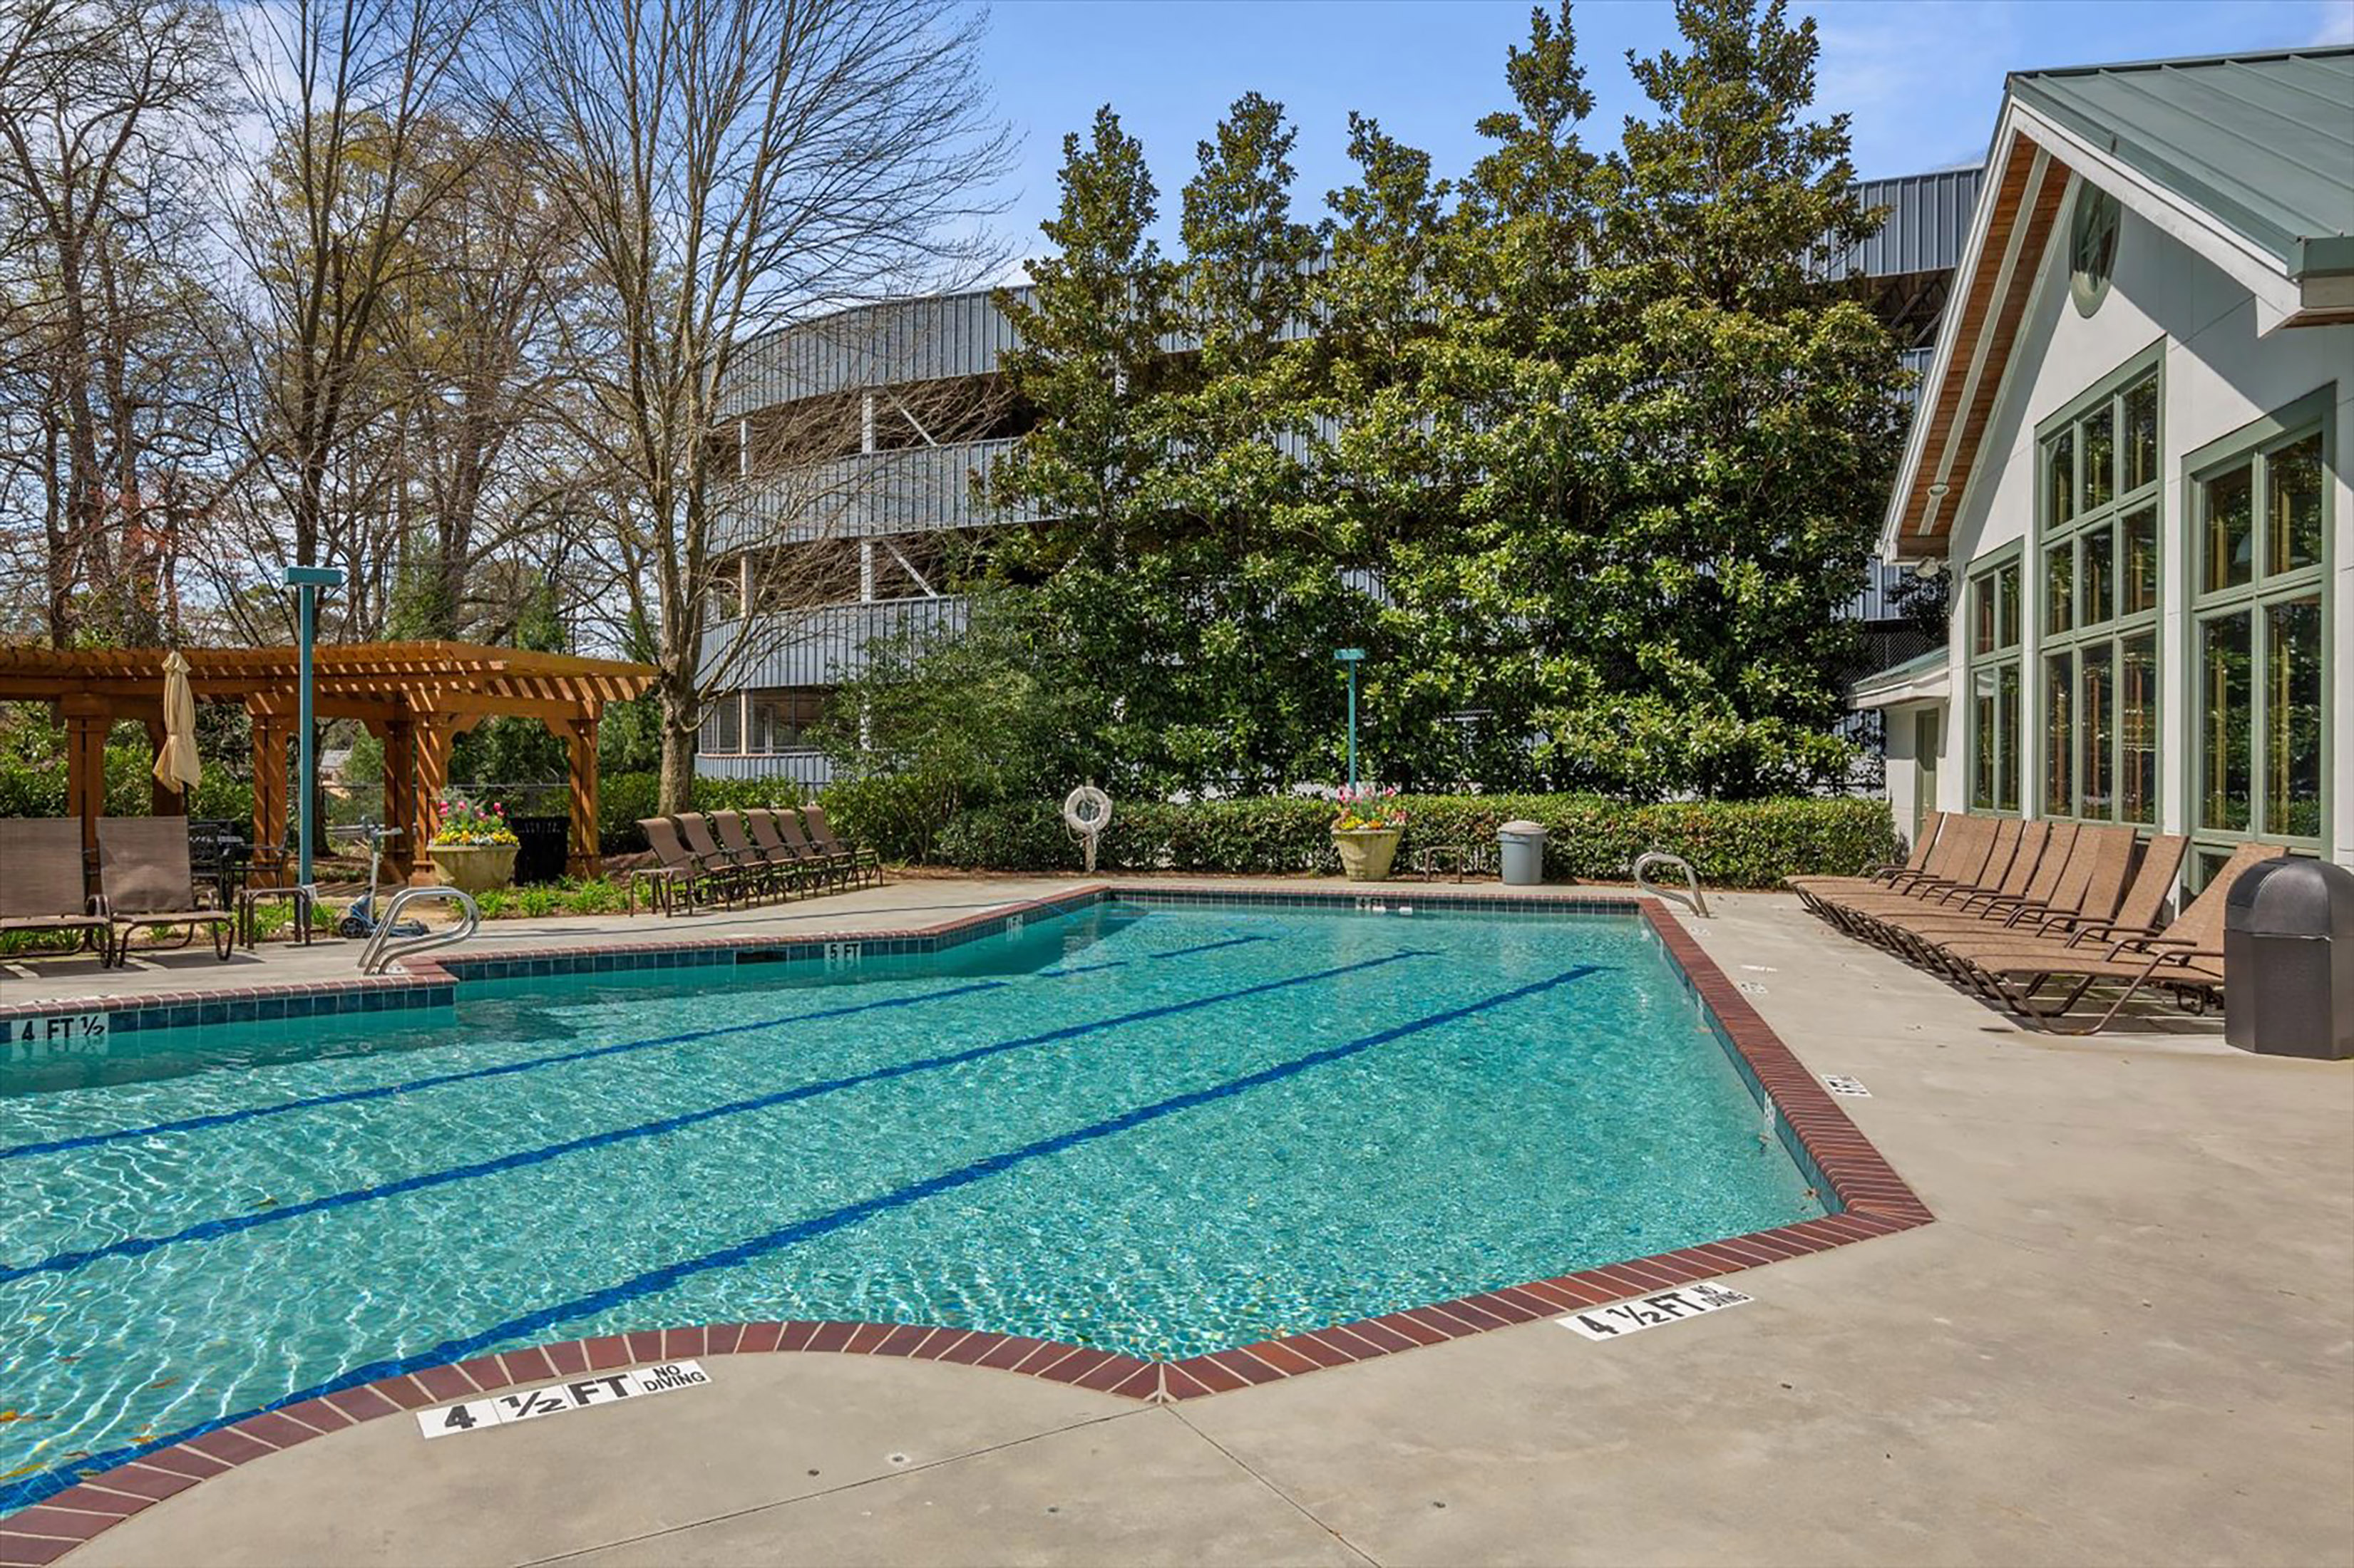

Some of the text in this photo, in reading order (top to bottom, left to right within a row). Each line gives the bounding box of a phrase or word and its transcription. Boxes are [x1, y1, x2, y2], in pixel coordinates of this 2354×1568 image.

[830, 944, 860, 960] 5 FT
[21, 1021, 35, 1041] 4
[46, 1018, 75, 1039] FT
[1576, 1315, 1620, 1335] 4
[1643, 1292, 1707, 1318] FT
[643, 1371, 706, 1392] DIVING
[655, 1363, 681, 1378] NO
[443, 1405, 477, 1430] 4
[568, 1374, 628, 1405] FT
